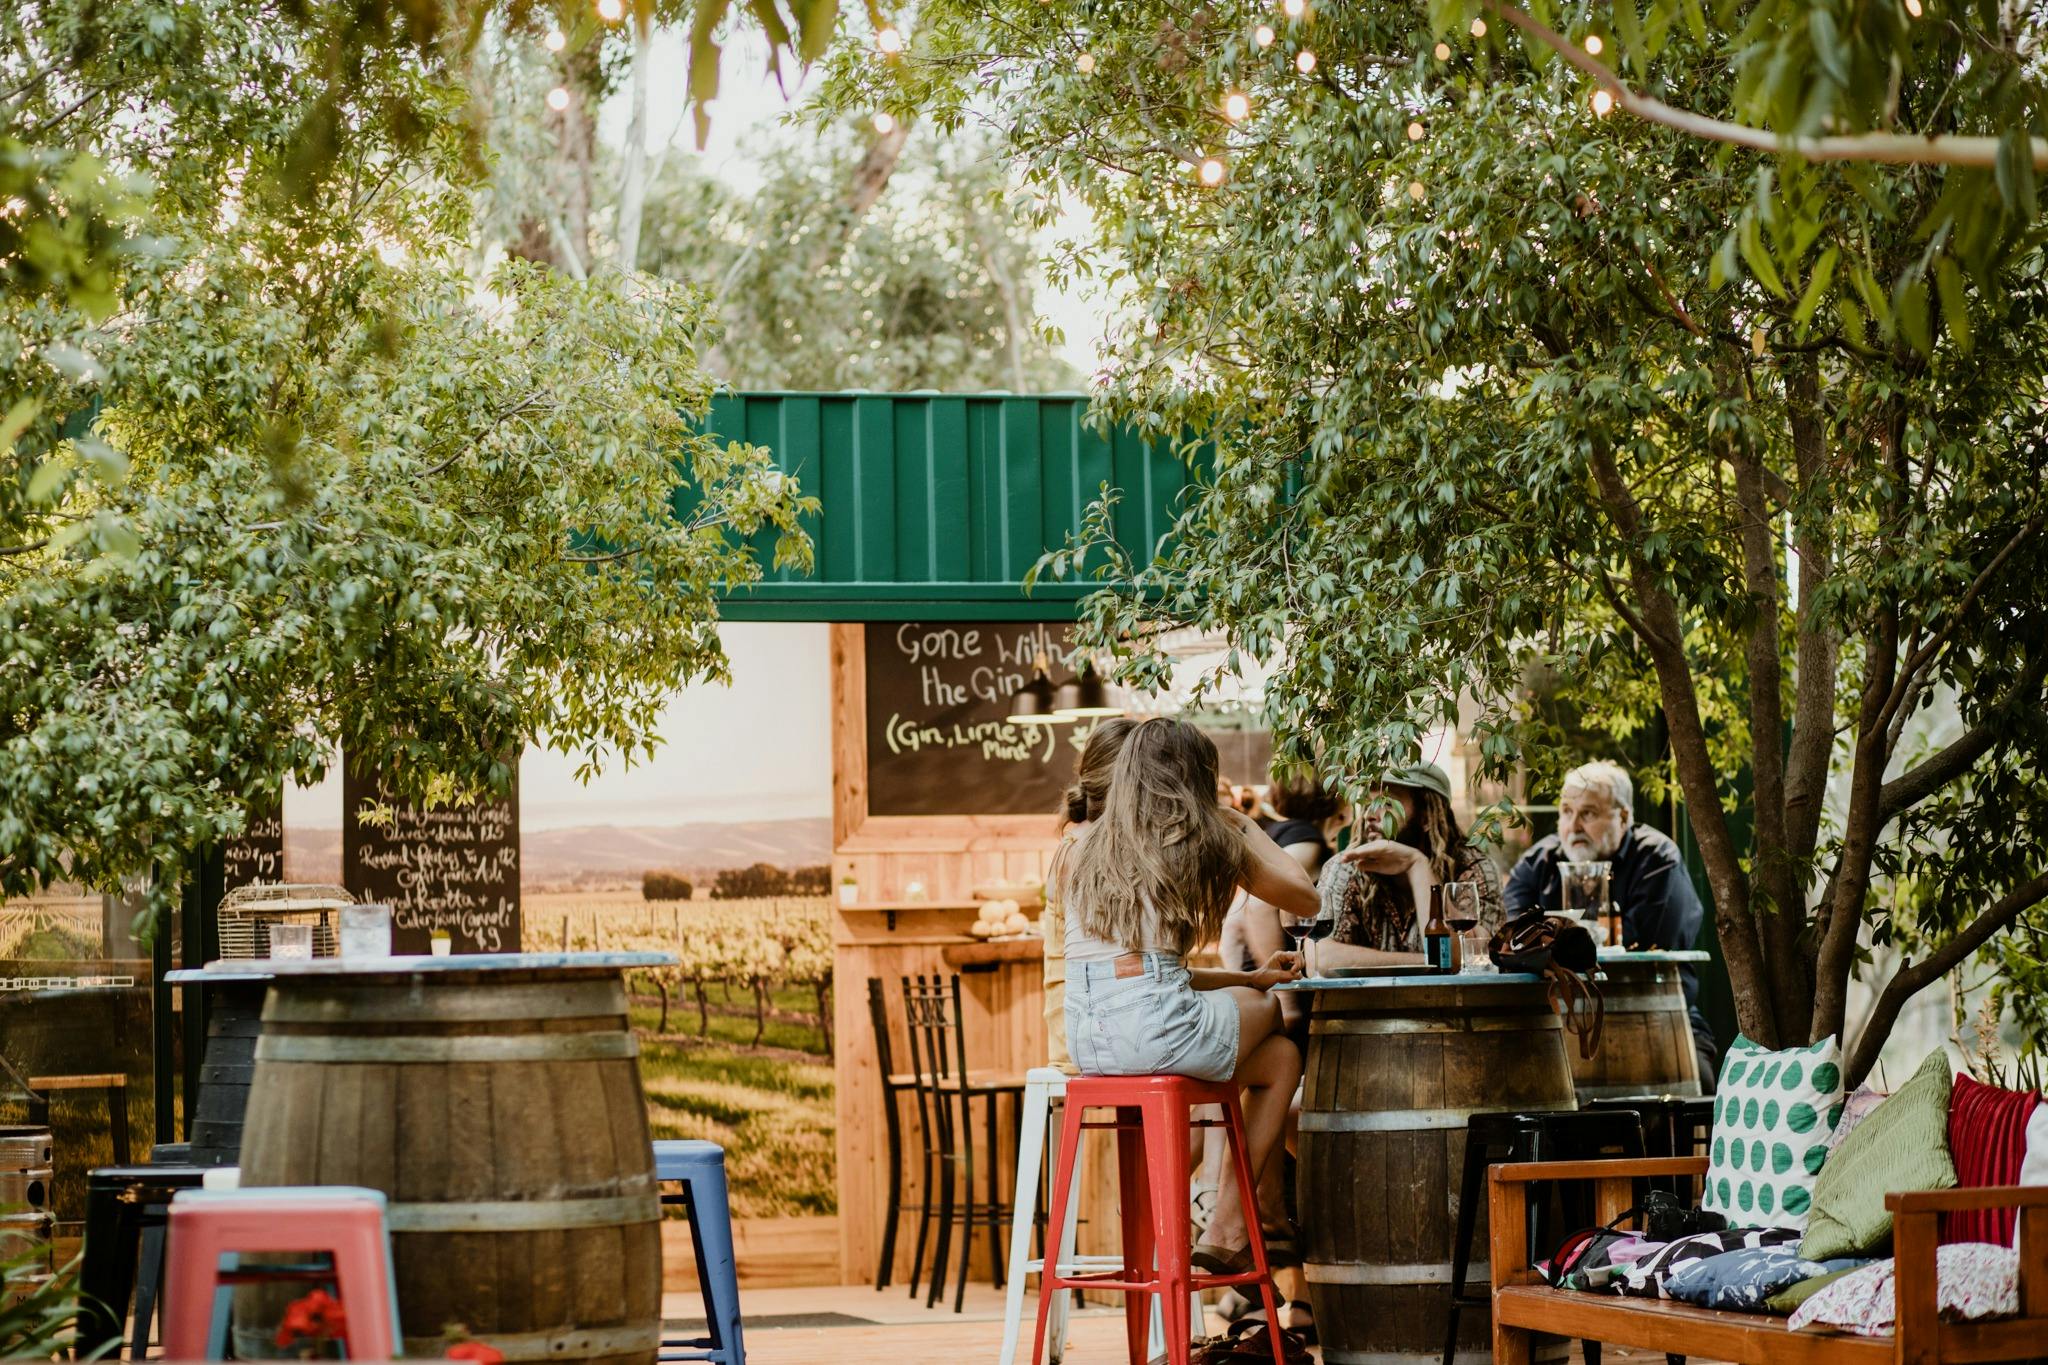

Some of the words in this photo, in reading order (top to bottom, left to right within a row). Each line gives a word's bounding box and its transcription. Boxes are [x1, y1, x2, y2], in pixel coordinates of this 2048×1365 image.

[896, 623, 982, 664] Gone
[994, 630, 1063, 666] With
[970, 666, 1024, 704] Gin
[953, 721, 1018, 744] Lime
